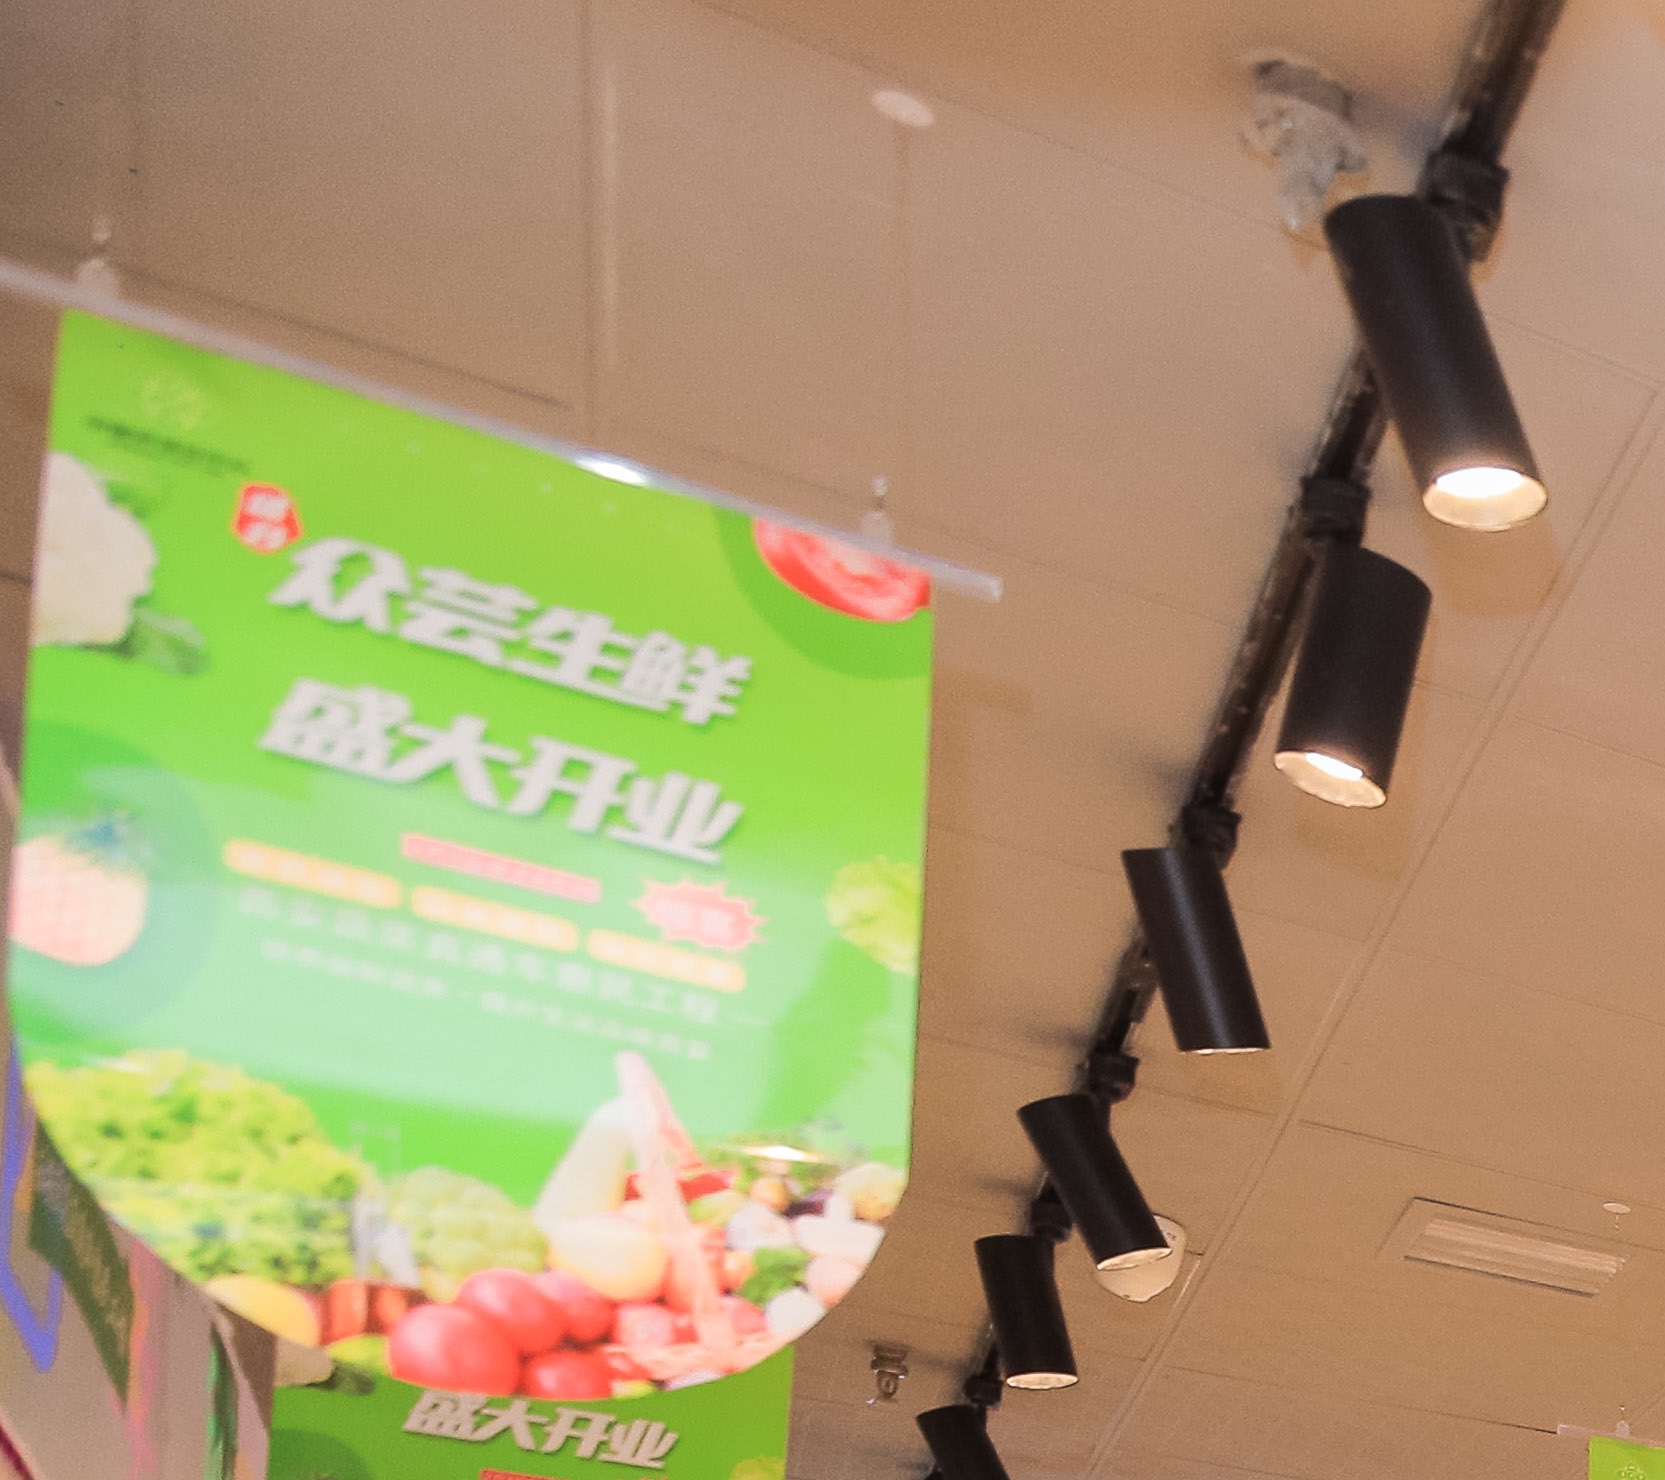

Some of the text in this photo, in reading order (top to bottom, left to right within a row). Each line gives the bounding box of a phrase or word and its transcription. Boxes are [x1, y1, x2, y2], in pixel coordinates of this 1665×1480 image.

[267, 536, 752, 727] 众芸生鲜
[258, 677, 743, 864] 盛大开业
[402, 1390, 680, 1469] 盛大开业
